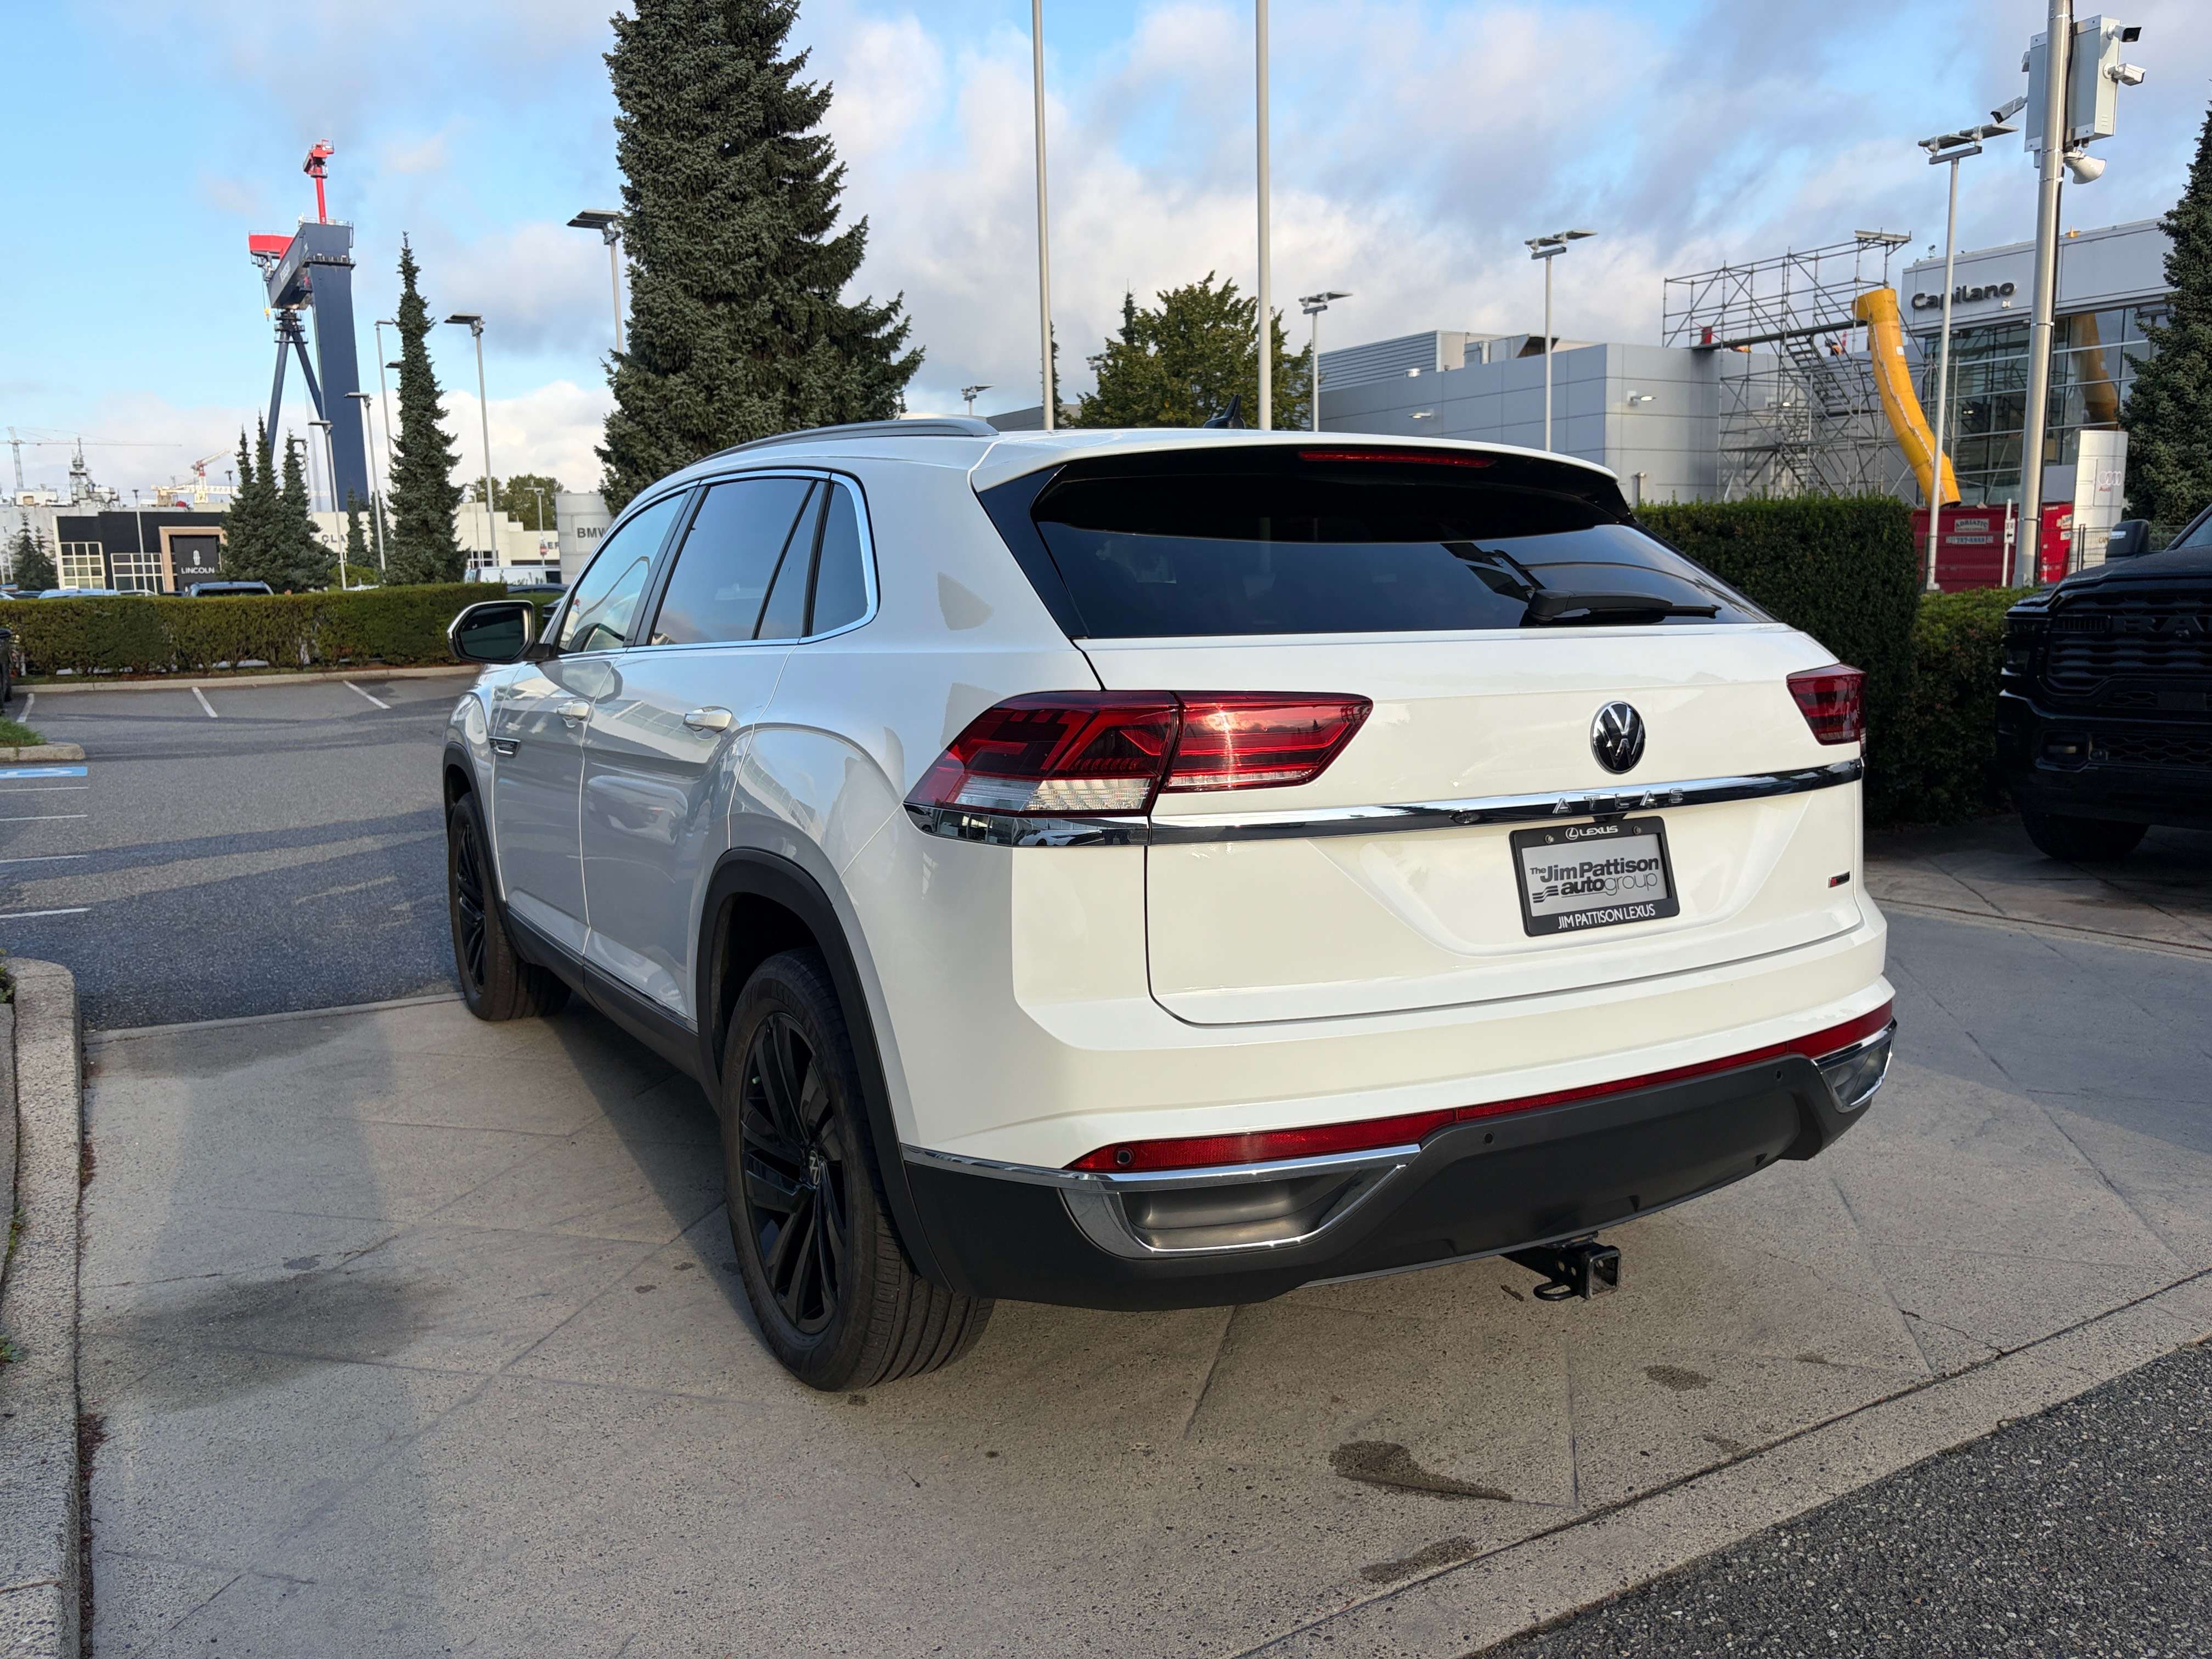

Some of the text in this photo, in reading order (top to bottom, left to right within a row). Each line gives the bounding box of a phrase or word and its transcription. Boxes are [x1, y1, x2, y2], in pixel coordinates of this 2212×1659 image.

[181, 566, 215, 574] LINCOLN
[1553, 788, 1684, 814] ATLAS
[1579, 825, 1618, 836] LEXUS
[1530, 857, 1659, 883] The Jim Pattison
[1561, 872, 1657, 896] autogroup
[1558, 903, 1656, 929] JIM PATTISON LEXUS
